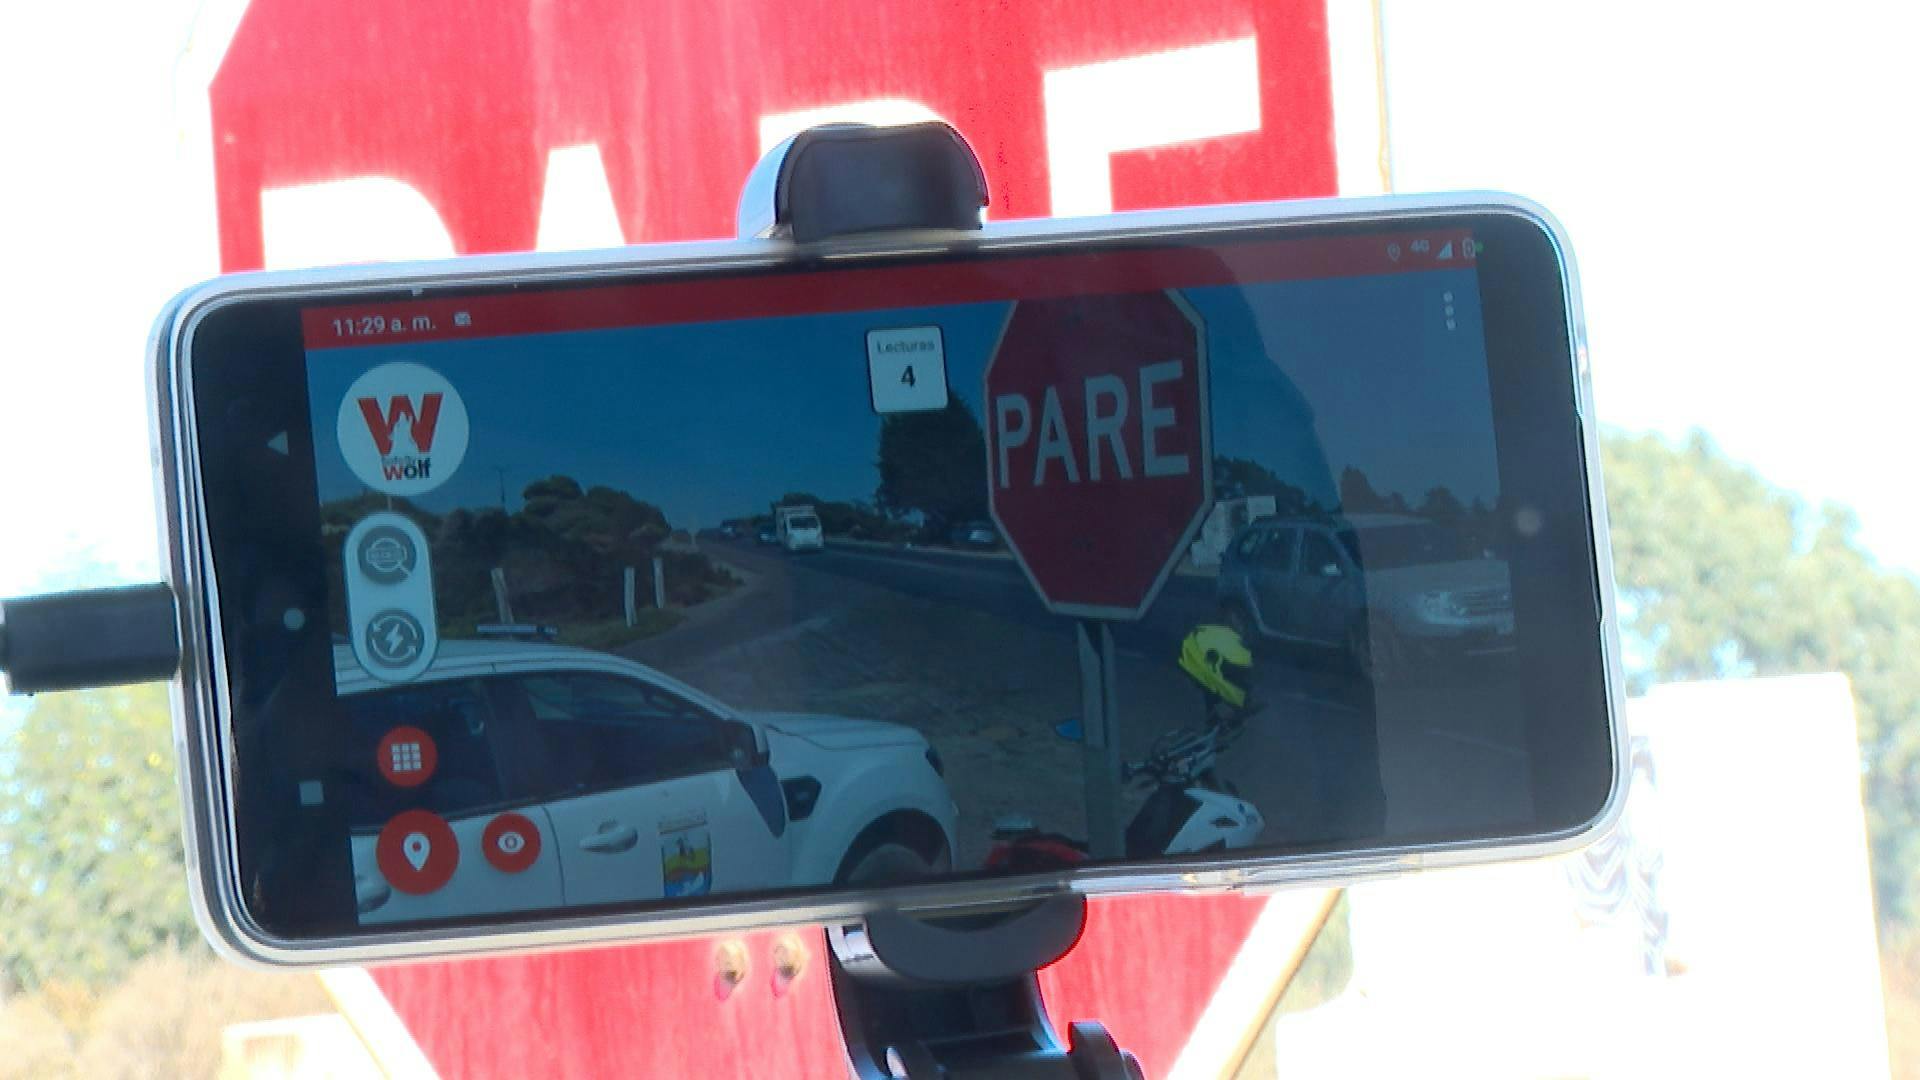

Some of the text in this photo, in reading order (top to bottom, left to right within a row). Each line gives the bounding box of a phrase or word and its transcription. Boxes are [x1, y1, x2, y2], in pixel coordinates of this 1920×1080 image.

[332, 316, 437, 336] 11:29 a. m.
[876, 339, 936, 354] Lecturas
[900, 365, 916, 389] 4
[357, 392, 444, 456] W
[996, 359, 1189, 489] PARE
[383, 458, 431, 481] wolf
